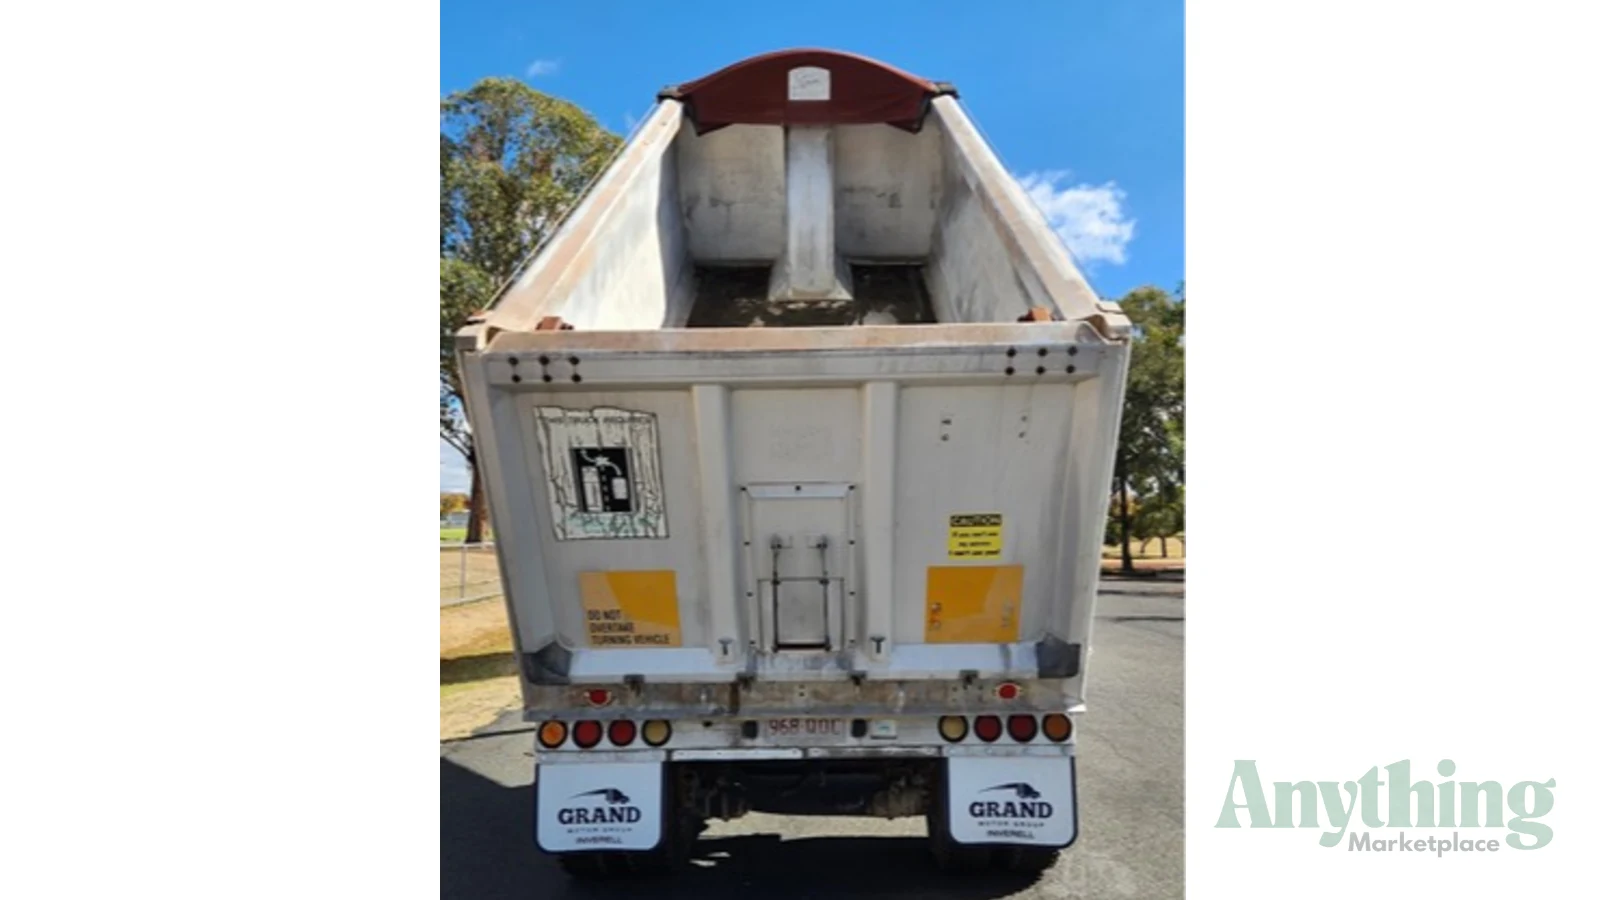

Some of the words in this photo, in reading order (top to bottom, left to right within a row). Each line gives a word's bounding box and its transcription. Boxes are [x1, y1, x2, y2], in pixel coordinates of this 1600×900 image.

[950, 515, 1002, 526] CAUTION
[587, 609, 601, 621] DO
[603, 609, 622, 621] NOT
[589, 622, 635, 634] OVERTAKE
[591, 635, 633, 646] TURNING
[633, 634, 671, 645] VEHICLE
[557, 806, 642, 825] GRAND
[969, 801, 1053, 819] GRAND
[986, 829, 1035, 840] INVERELL
